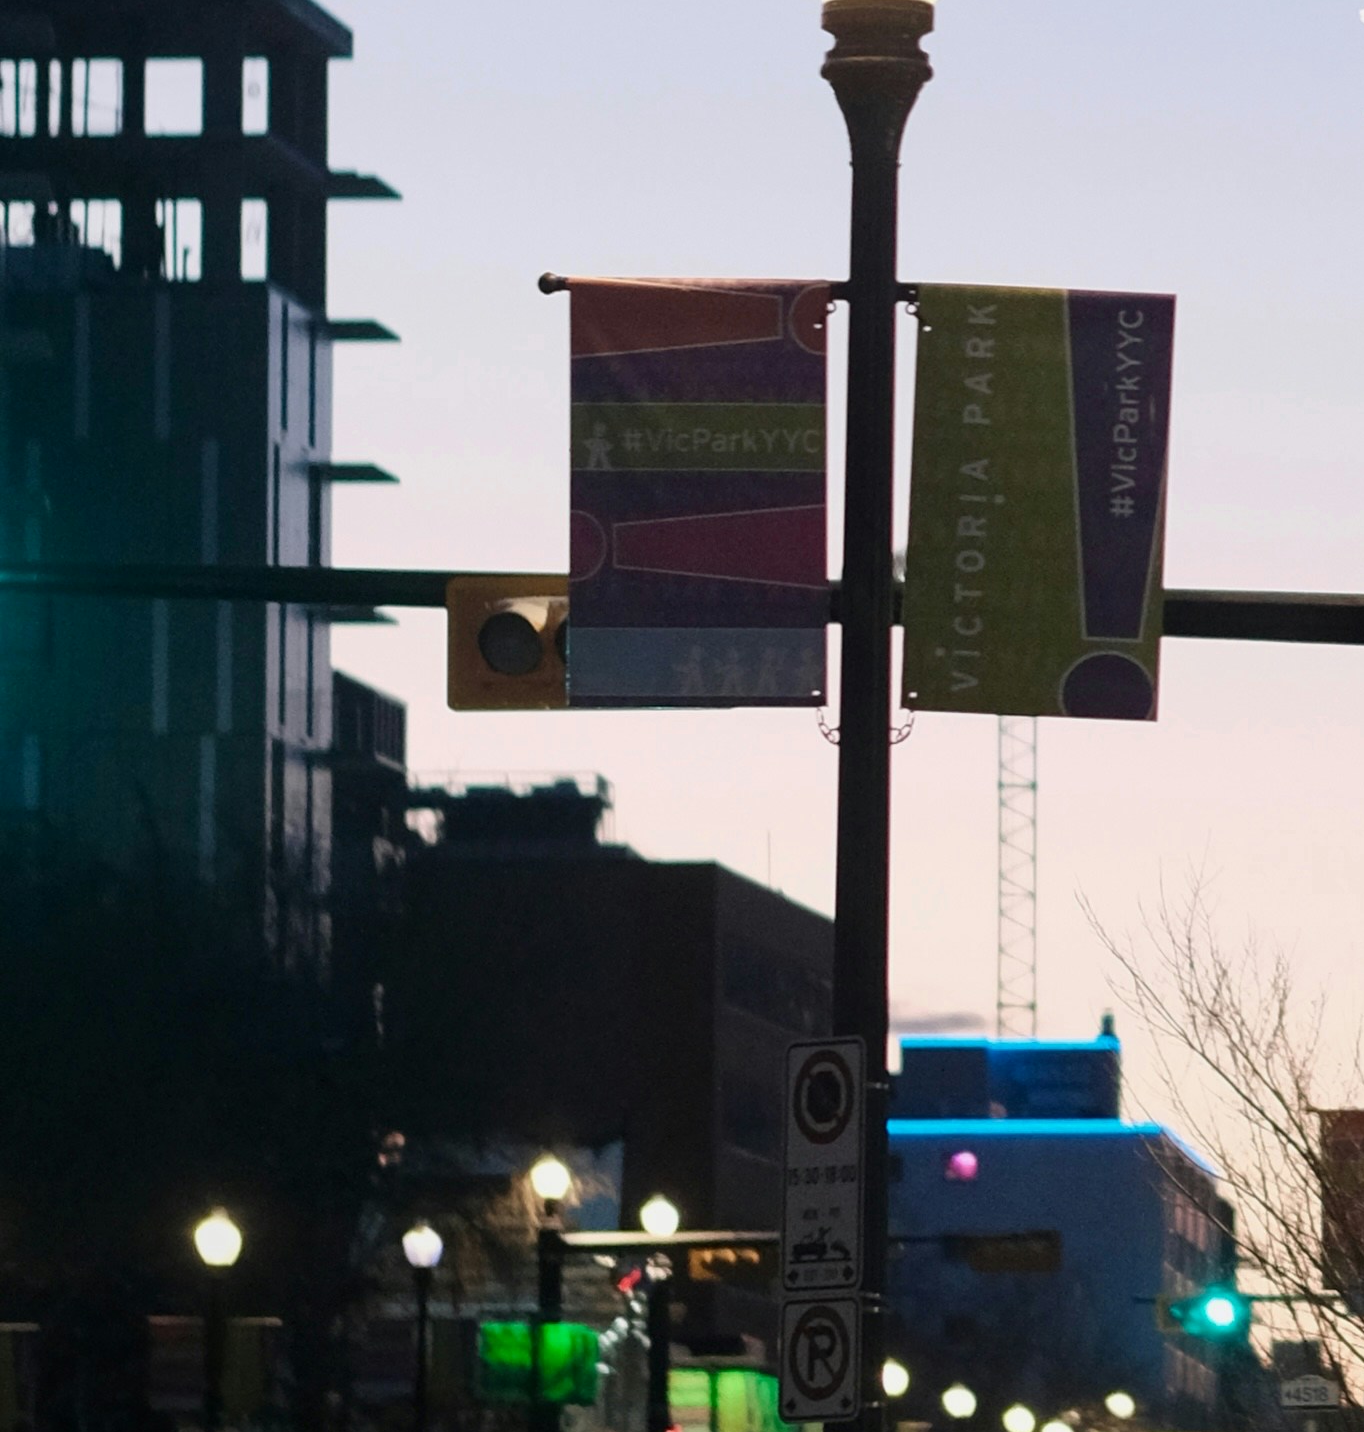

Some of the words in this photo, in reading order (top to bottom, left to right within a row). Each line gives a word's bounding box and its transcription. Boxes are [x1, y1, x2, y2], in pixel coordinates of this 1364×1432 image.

[962, 301, 999, 426] PARK
[1108, 307, 1146, 520] #VicParkYYC
[621, 424, 822, 457] #VicParkYYC
